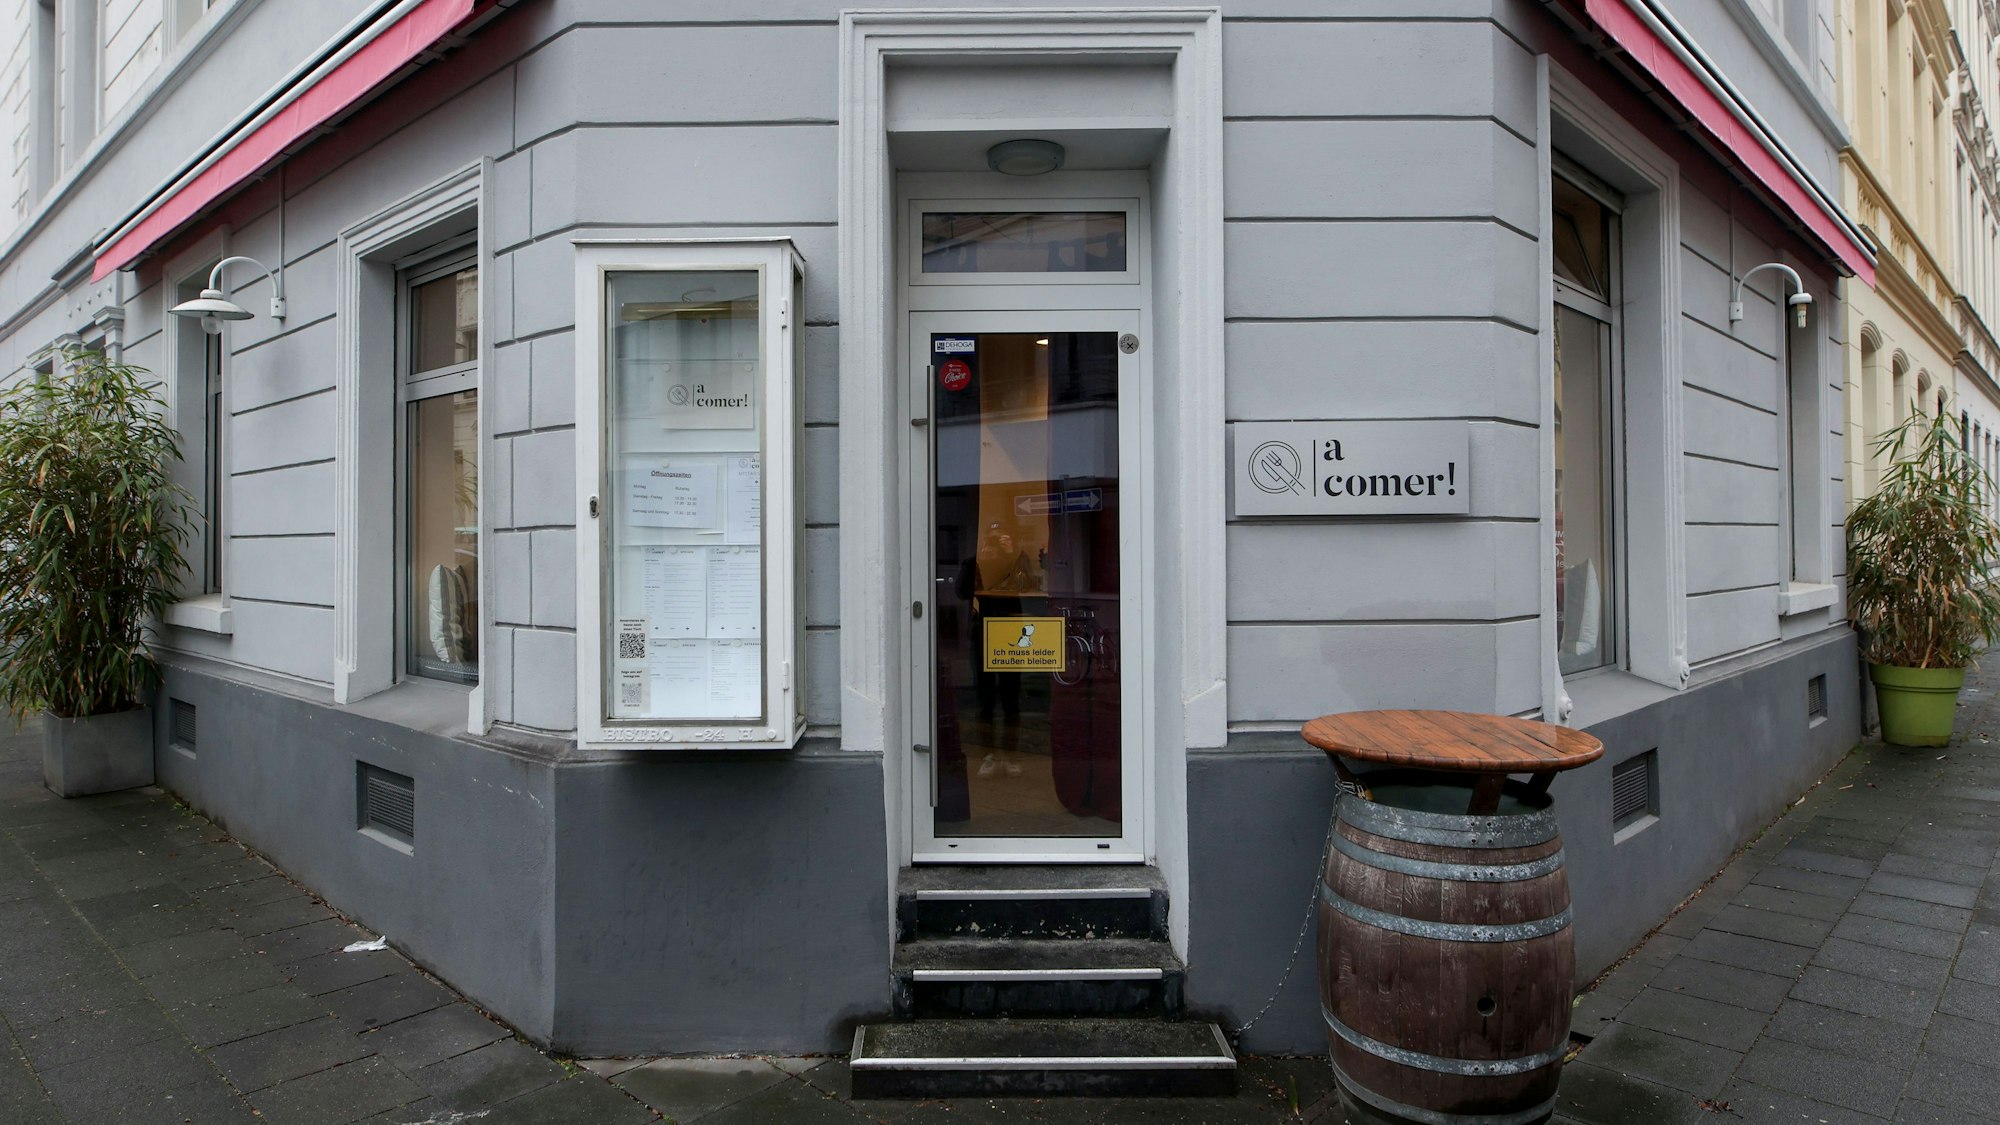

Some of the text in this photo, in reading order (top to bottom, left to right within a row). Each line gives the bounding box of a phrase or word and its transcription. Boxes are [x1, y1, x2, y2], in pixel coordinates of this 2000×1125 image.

[697, 384, 705, 393] a
[697, 394, 748, 407] comer!
[1323, 439, 1345, 461] a
[651, 470, 692, 479] Öffnungszeiten
[1323, 462, 1456, 497] comer!
[603, 728, 674, 742] BISTRO
